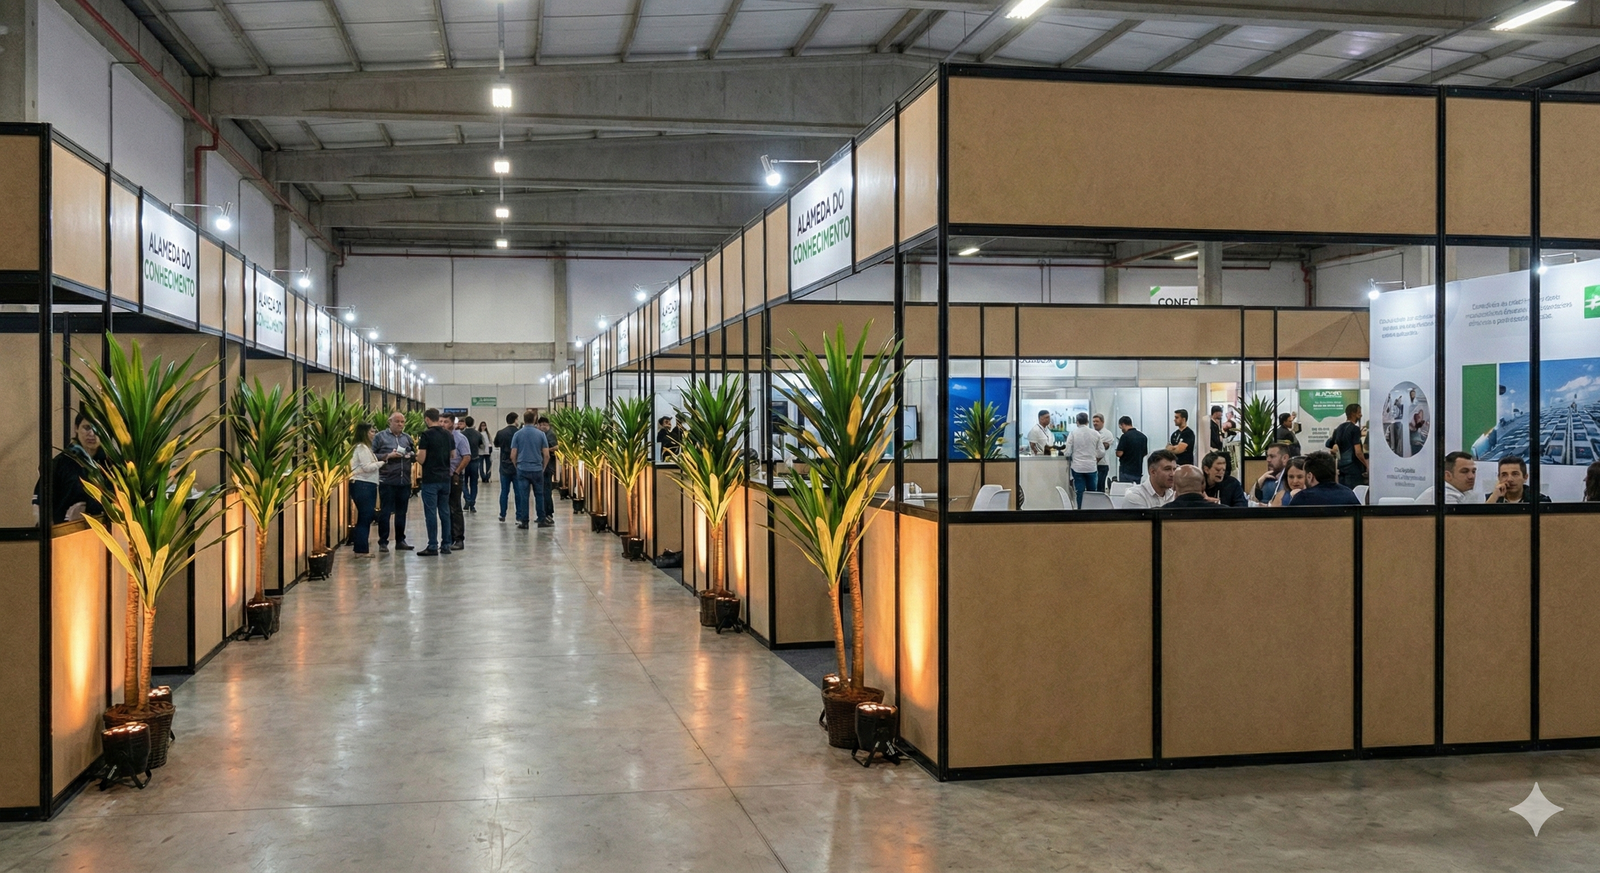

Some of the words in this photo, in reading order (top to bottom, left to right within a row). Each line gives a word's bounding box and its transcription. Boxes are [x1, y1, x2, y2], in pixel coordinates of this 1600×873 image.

[797, 197, 831, 236] ALAMEDA
[832, 187, 845, 215] DO
[148, 231, 181, 266] ALAMEDA
[181, 248, 192, 270] DO
[793, 215, 851, 265] CONHECIMENTO
[144, 258, 195, 298] CONHECIMENTO
[1158, 298, 1199, 306] CONEC
